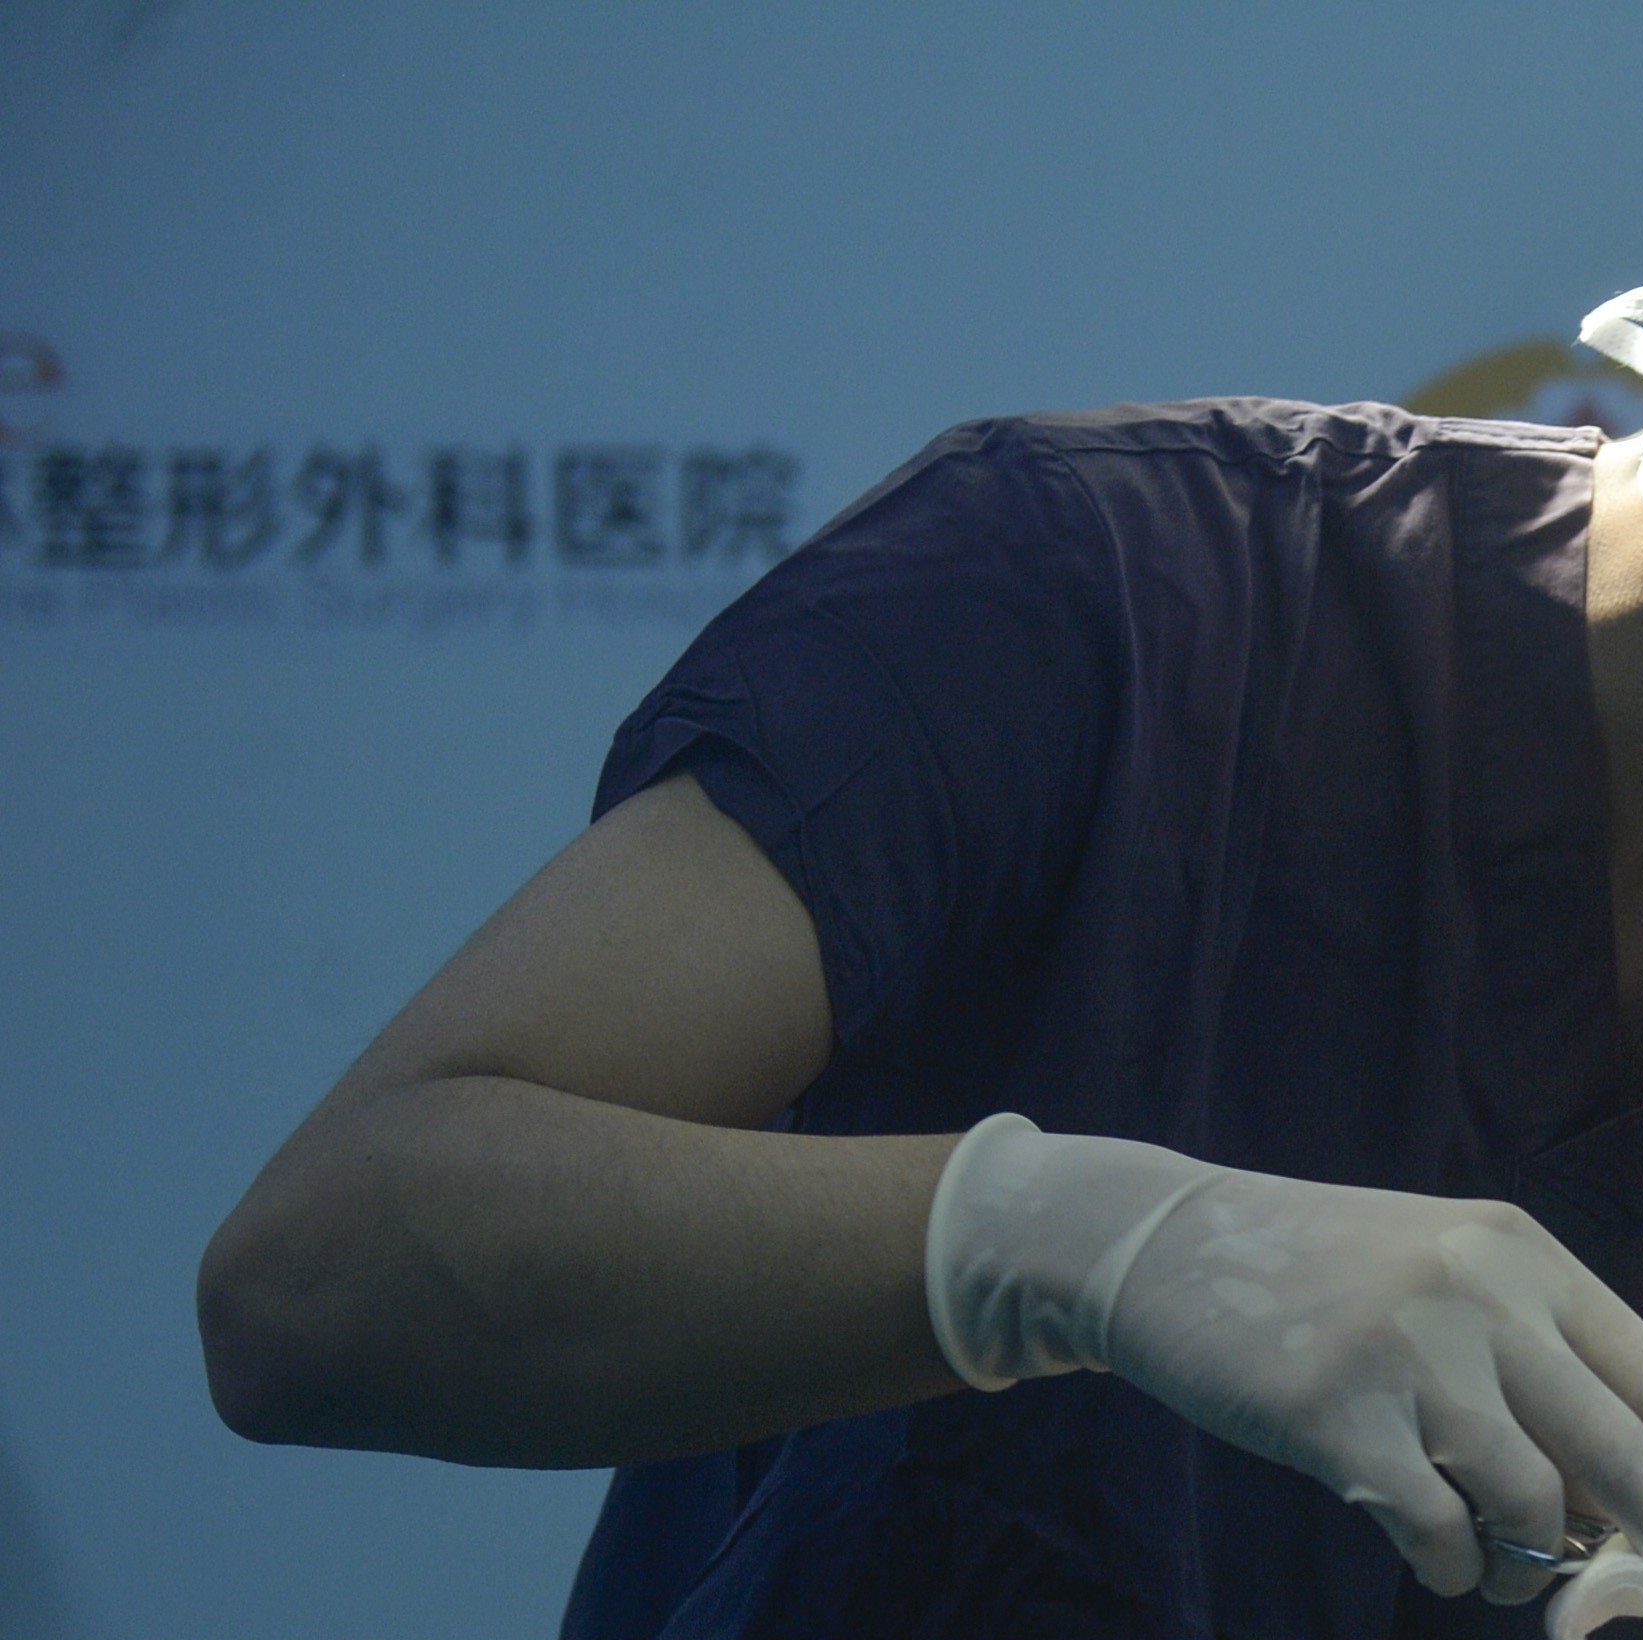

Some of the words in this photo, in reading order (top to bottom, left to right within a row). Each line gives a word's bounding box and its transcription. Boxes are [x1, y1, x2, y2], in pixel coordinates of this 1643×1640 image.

[0, 440, 802, 570] 整形外科医院
